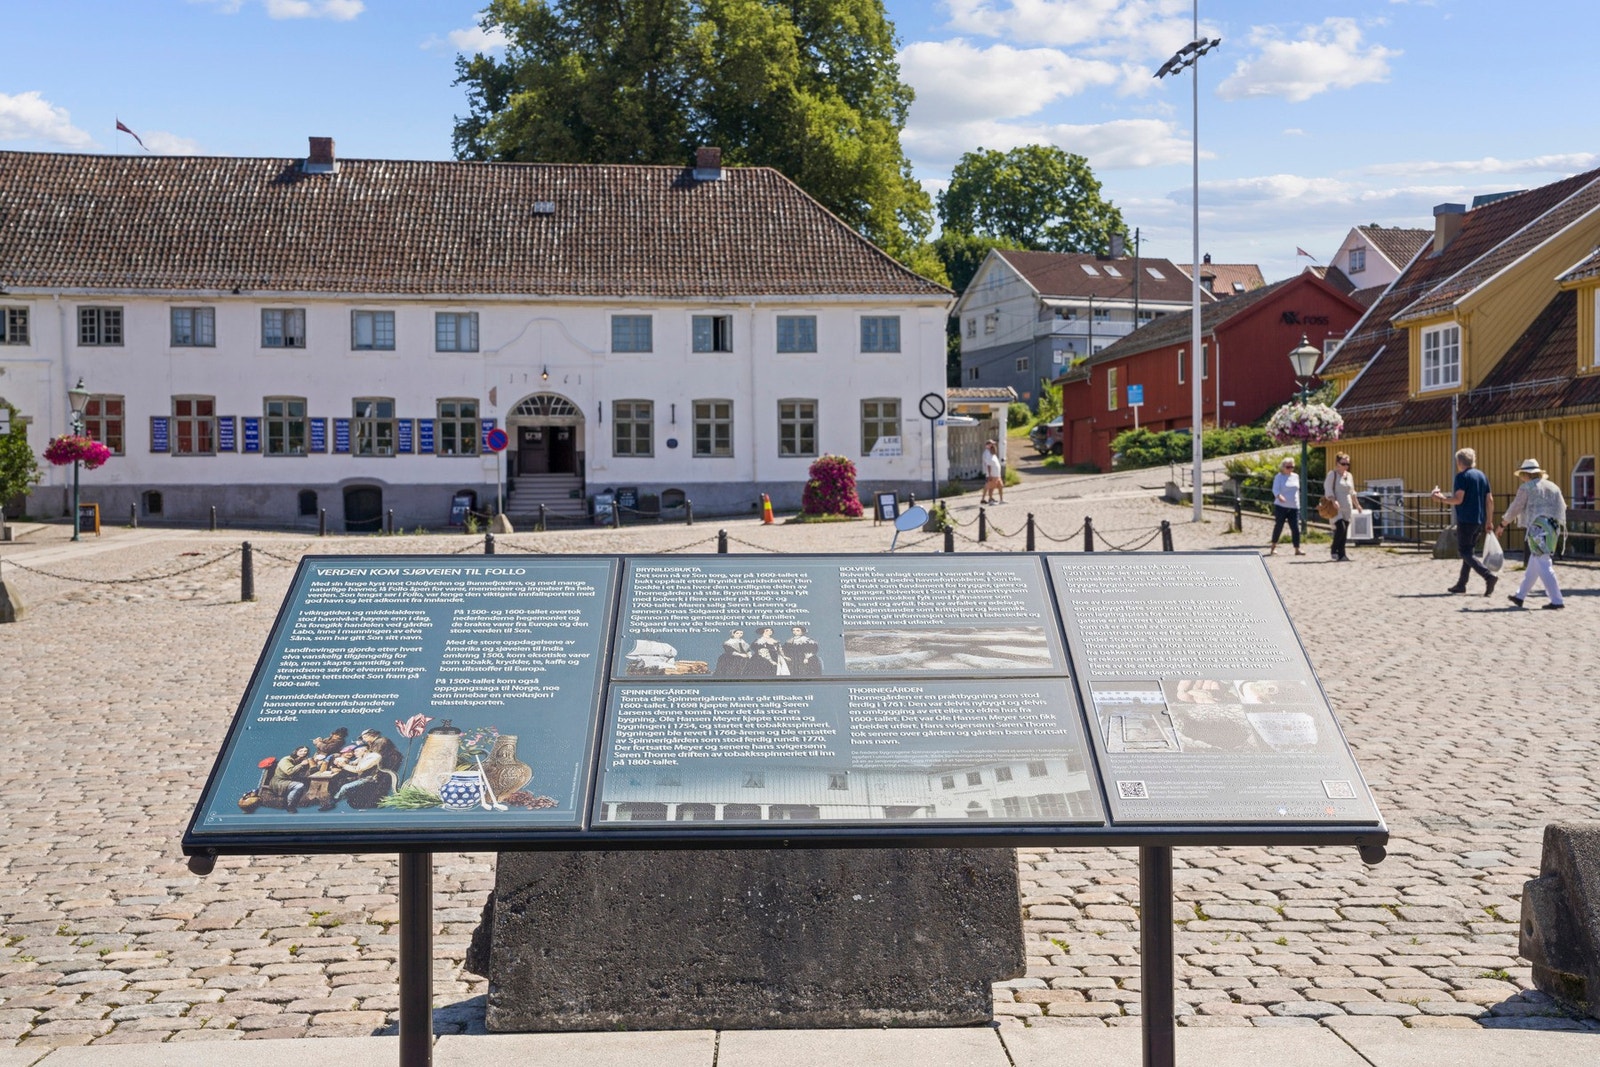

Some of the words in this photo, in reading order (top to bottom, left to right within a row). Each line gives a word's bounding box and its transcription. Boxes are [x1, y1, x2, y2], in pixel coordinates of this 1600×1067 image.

[317, 568, 367, 576] VERDEN
[369, 568, 399, 576] KOM
[443, 652, 480, 660] omkring
[514, 665, 546, 673] Europa.
[667, 695, 736, 703] Spinnerigården
[849, 693, 912, 702] Thornegården
[938, 693, 998, 701] praktbygning
[430, 699, 505, 707] trelasteksporten.
[760, 701, 781, 709] salig
[340, 707, 384, 715] oslofjord-
[922, 729, 955, 738] gården
[971, 729, 1003, 737] gården
[724, 750, 807, 758] tobakksspinneriet
[612, 759, 624, 767] på
